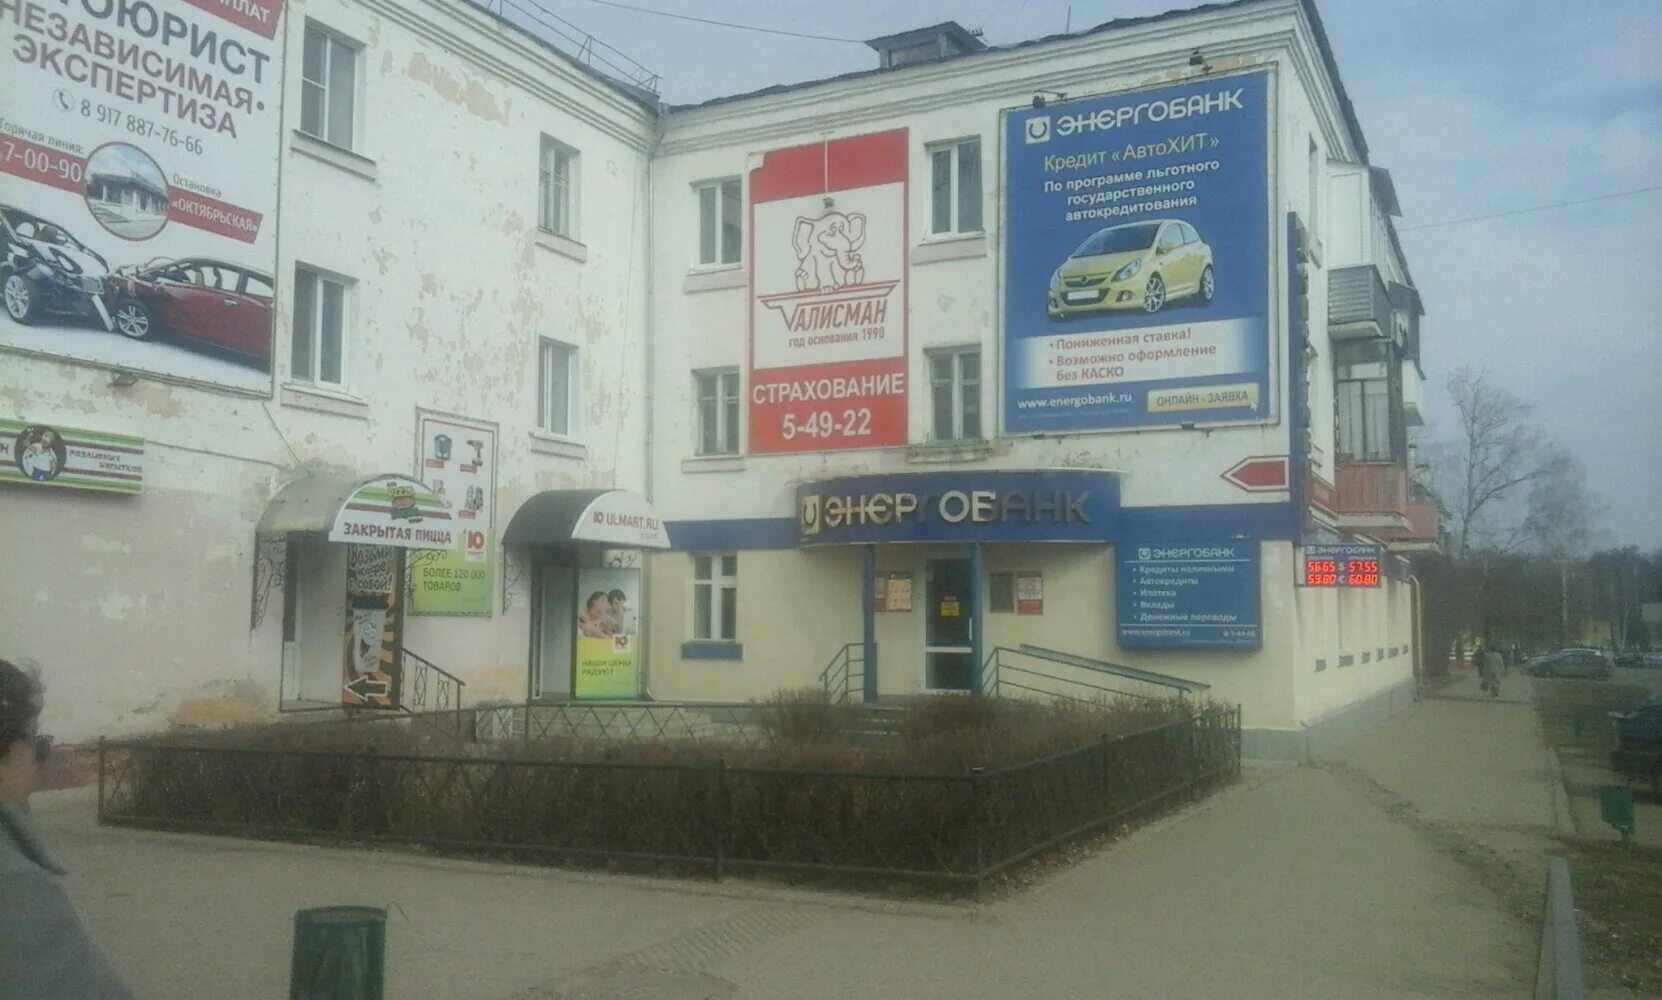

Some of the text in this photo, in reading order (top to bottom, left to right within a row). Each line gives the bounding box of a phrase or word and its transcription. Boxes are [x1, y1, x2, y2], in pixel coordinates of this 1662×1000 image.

[0, 0, 253, 115] НЕЗАВИСИМАЯ
[12, 33, 237, 139] ЭКСПЕРТИЗА
[1056, 88, 1244, 136] ЭНЕРГОБАНК
[80, 98, 203, 156] 8 917 887-76-66
[1044, 132, 1220, 173] Кредит «АвтоХИТ»
[172, 172, 222, 198] Остановка
[1044, 160, 1220, 193] По программе льготного
[1067, 179, 1195, 206] государственного
[171, 198, 258, 234] «ОКТЯБРЬСКАЯ»
[1065, 195, 1198, 222] автокредитования
[789, 327, 885, 348] год основания 1990
[1056, 327, 1192, 350] Пониженная ставка!
[1056, 344, 1217, 367] Возможно оформление
[1056, 366, 1124, 381] без КАСКО
[753, 373, 904, 404] СТРАХОВАНИЕ
[1017, 393, 1132, 410] www.energobank.ru
[782, 408, 871, 440] 5-49-22
[343, 522, 452, 544] ЗАКРЫТАЯ ПИЦЦА
[606, 513, 659, 531] ULMART.RU
[423, 568, 453, 578] БОЛЕЕ
[1139, 565, 1178, 575] Кредиты
[423, 581, 462, 592] ТОВАРОВ
